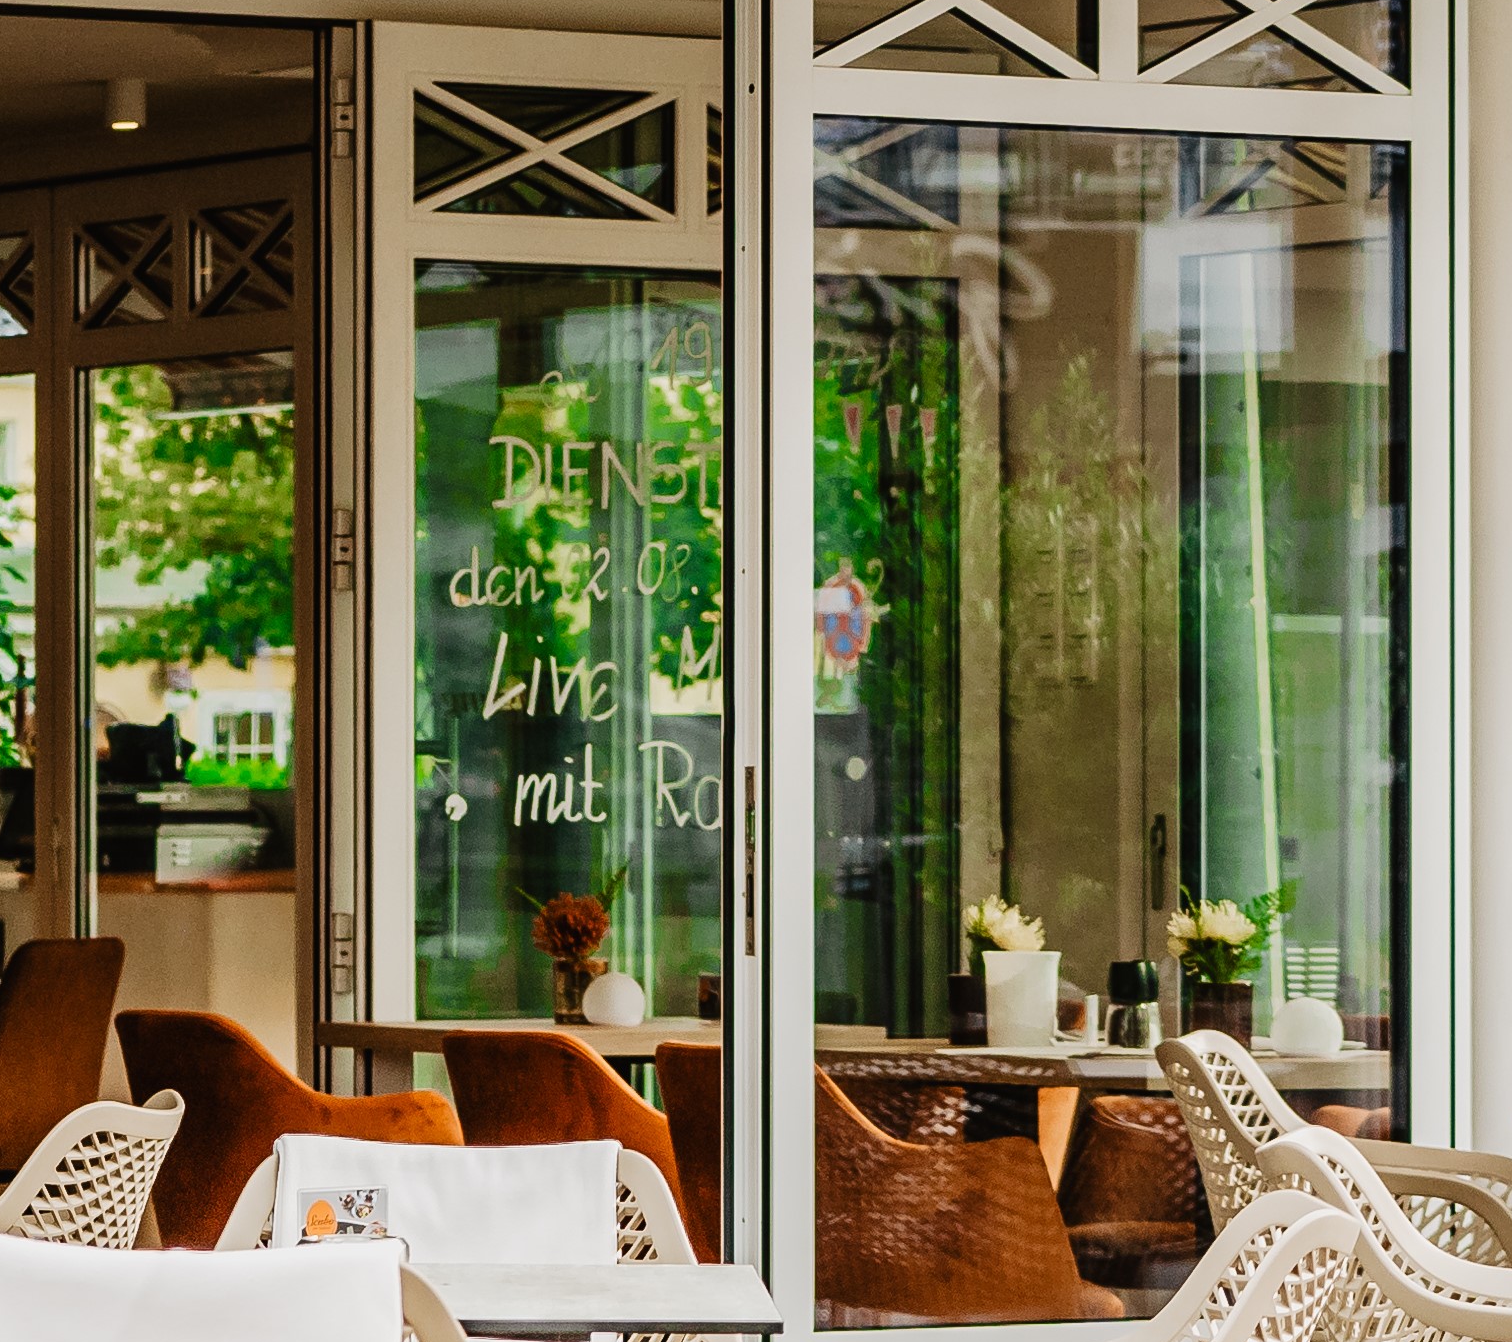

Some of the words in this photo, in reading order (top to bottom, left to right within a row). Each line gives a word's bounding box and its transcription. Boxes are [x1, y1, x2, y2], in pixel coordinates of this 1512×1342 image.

[650, 321, 712, 390] 19
[489, 435, 721, 509] DIENST
[449, 545, 544, 607] den
[482, 631, 618, 721] Live
[676, 624, 721, 704] M
[514, 742, 607, 827] mit
